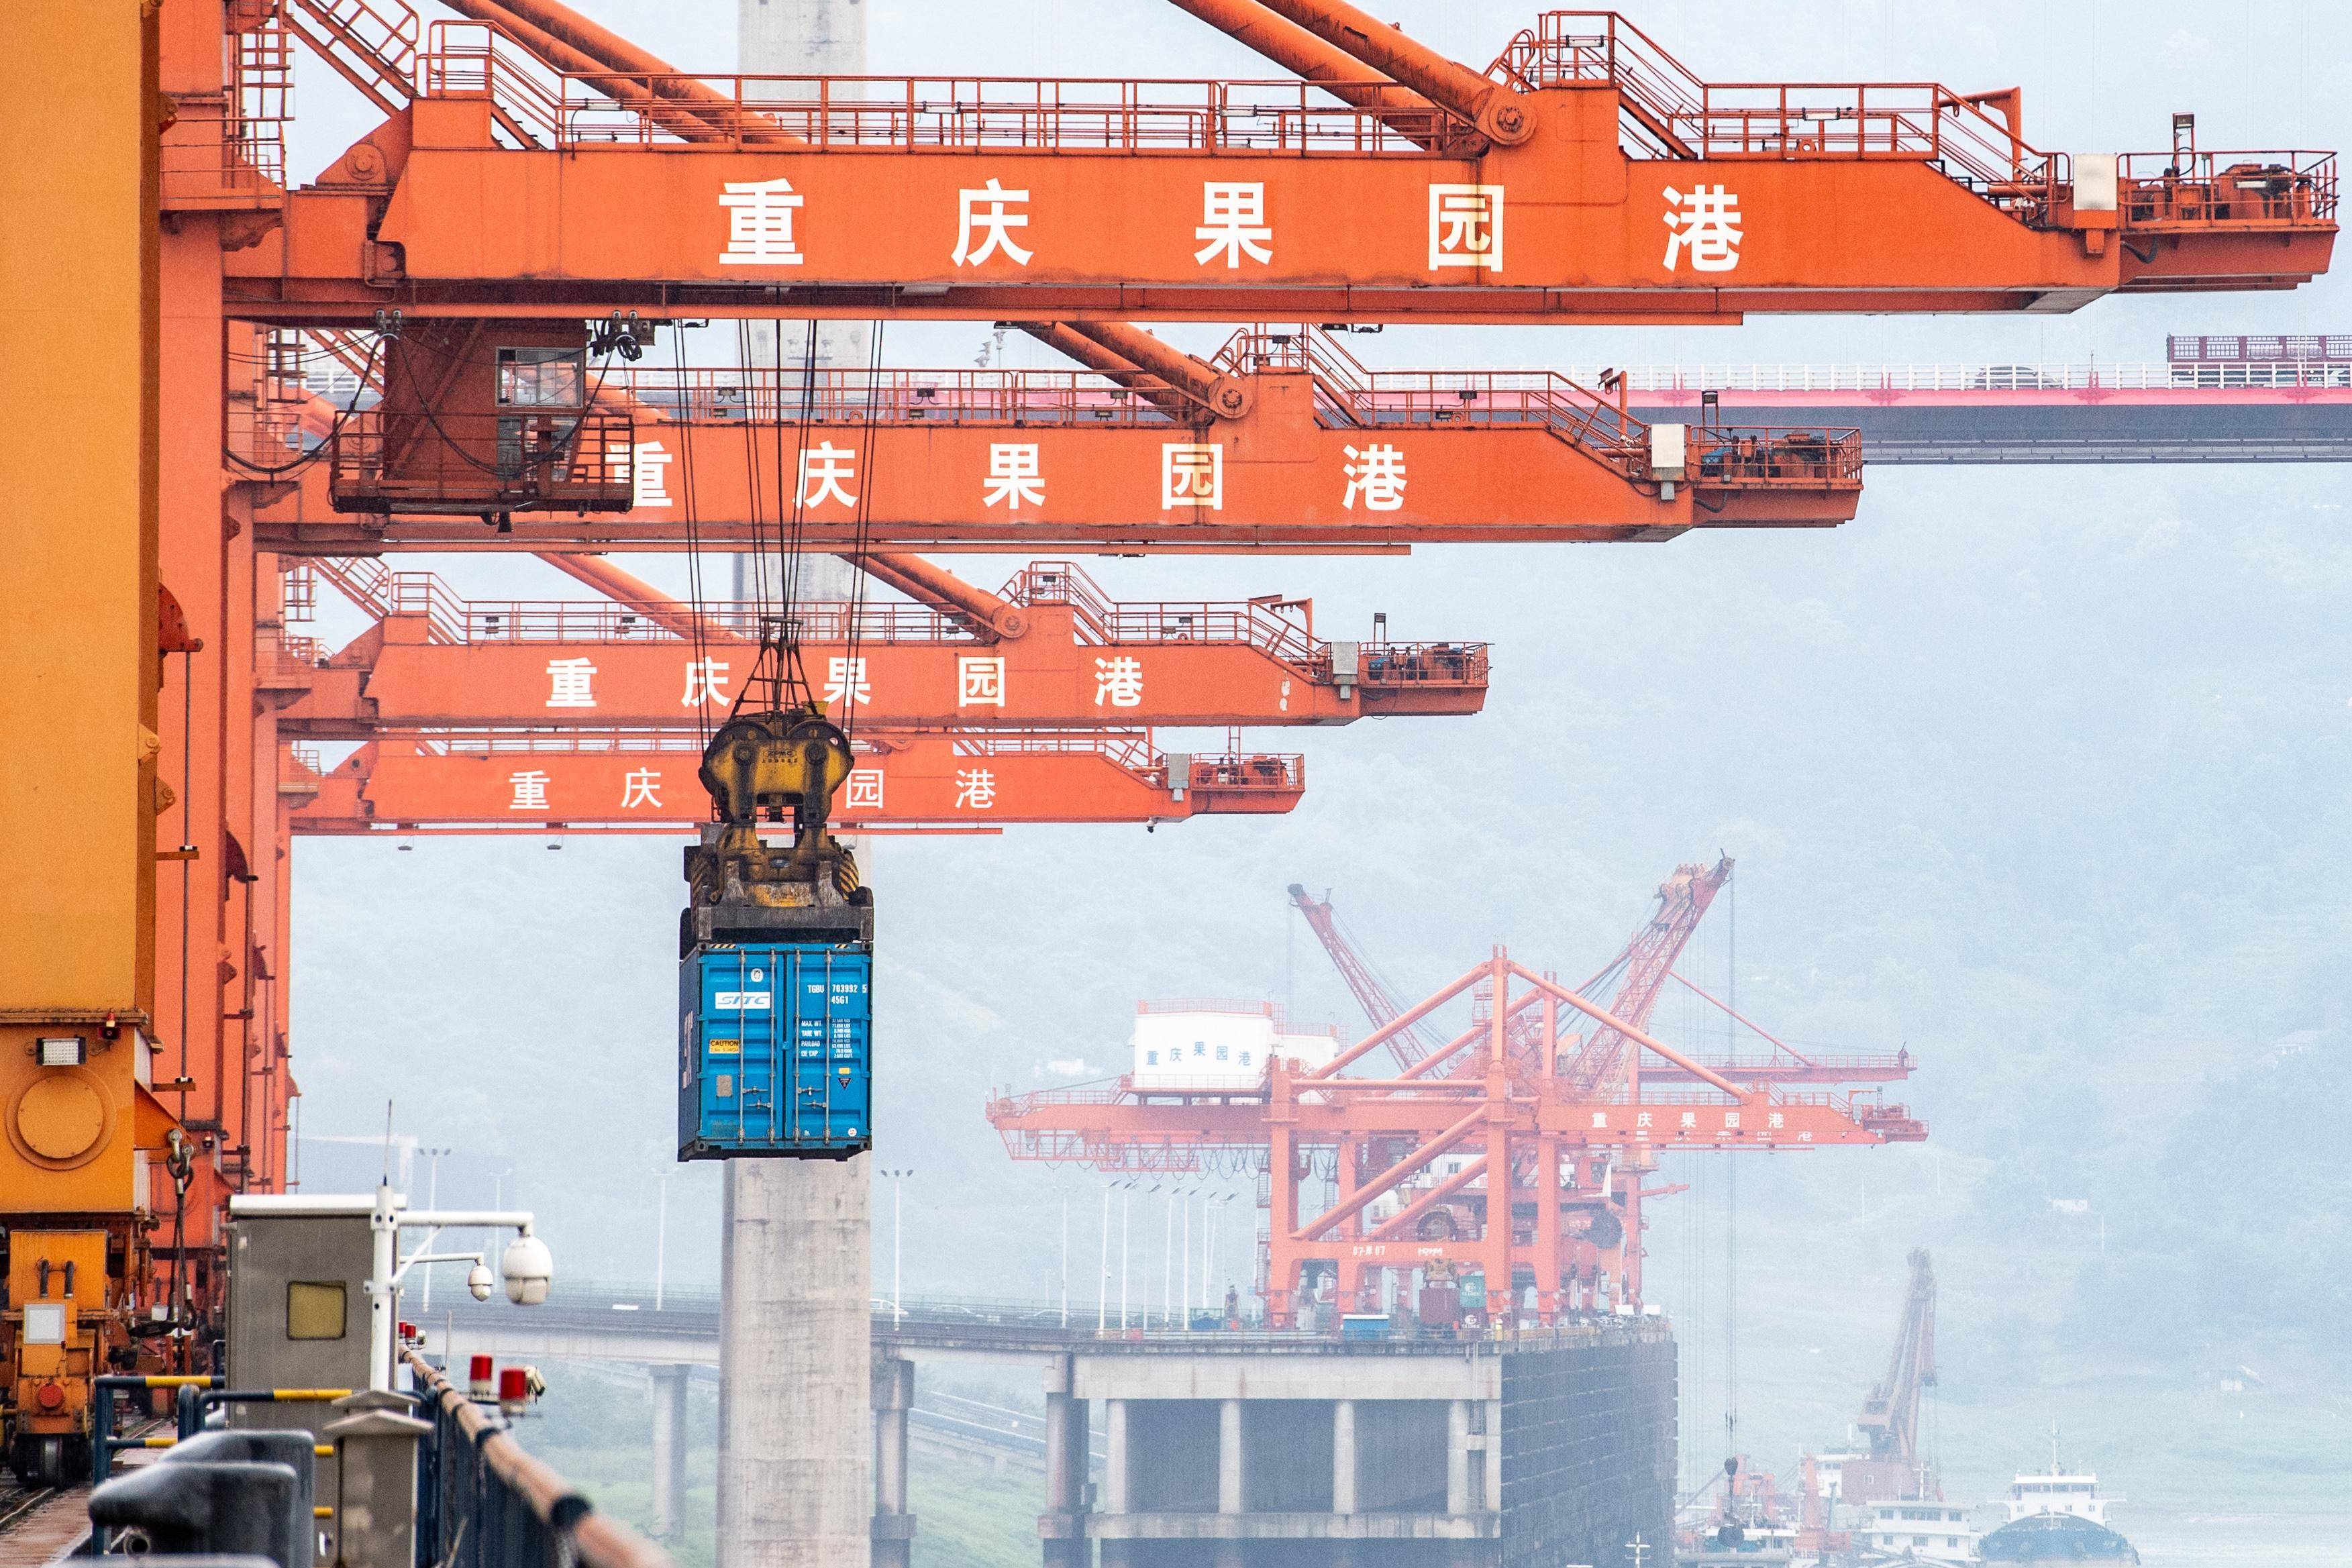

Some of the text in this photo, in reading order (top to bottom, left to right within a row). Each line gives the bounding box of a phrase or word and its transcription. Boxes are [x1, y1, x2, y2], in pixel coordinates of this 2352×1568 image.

[719, 178, 1743, 272] 重庆果园港
[607, 440, 1408, 511] 重庆果园港
[546, 656, 1144, 709] 重庆果园港
[509, 766, 996, 810] 重庆园港
[717, 996, 769, 1004] SITC
[807, 984, 868, 993] TGBU 703992 5
[831, 996, 849, 1004] 45G1
[1146, 1041, 1251, 1066] 重庆果园港
[1592, 1112, 1784, 1128] 重庆果园港
